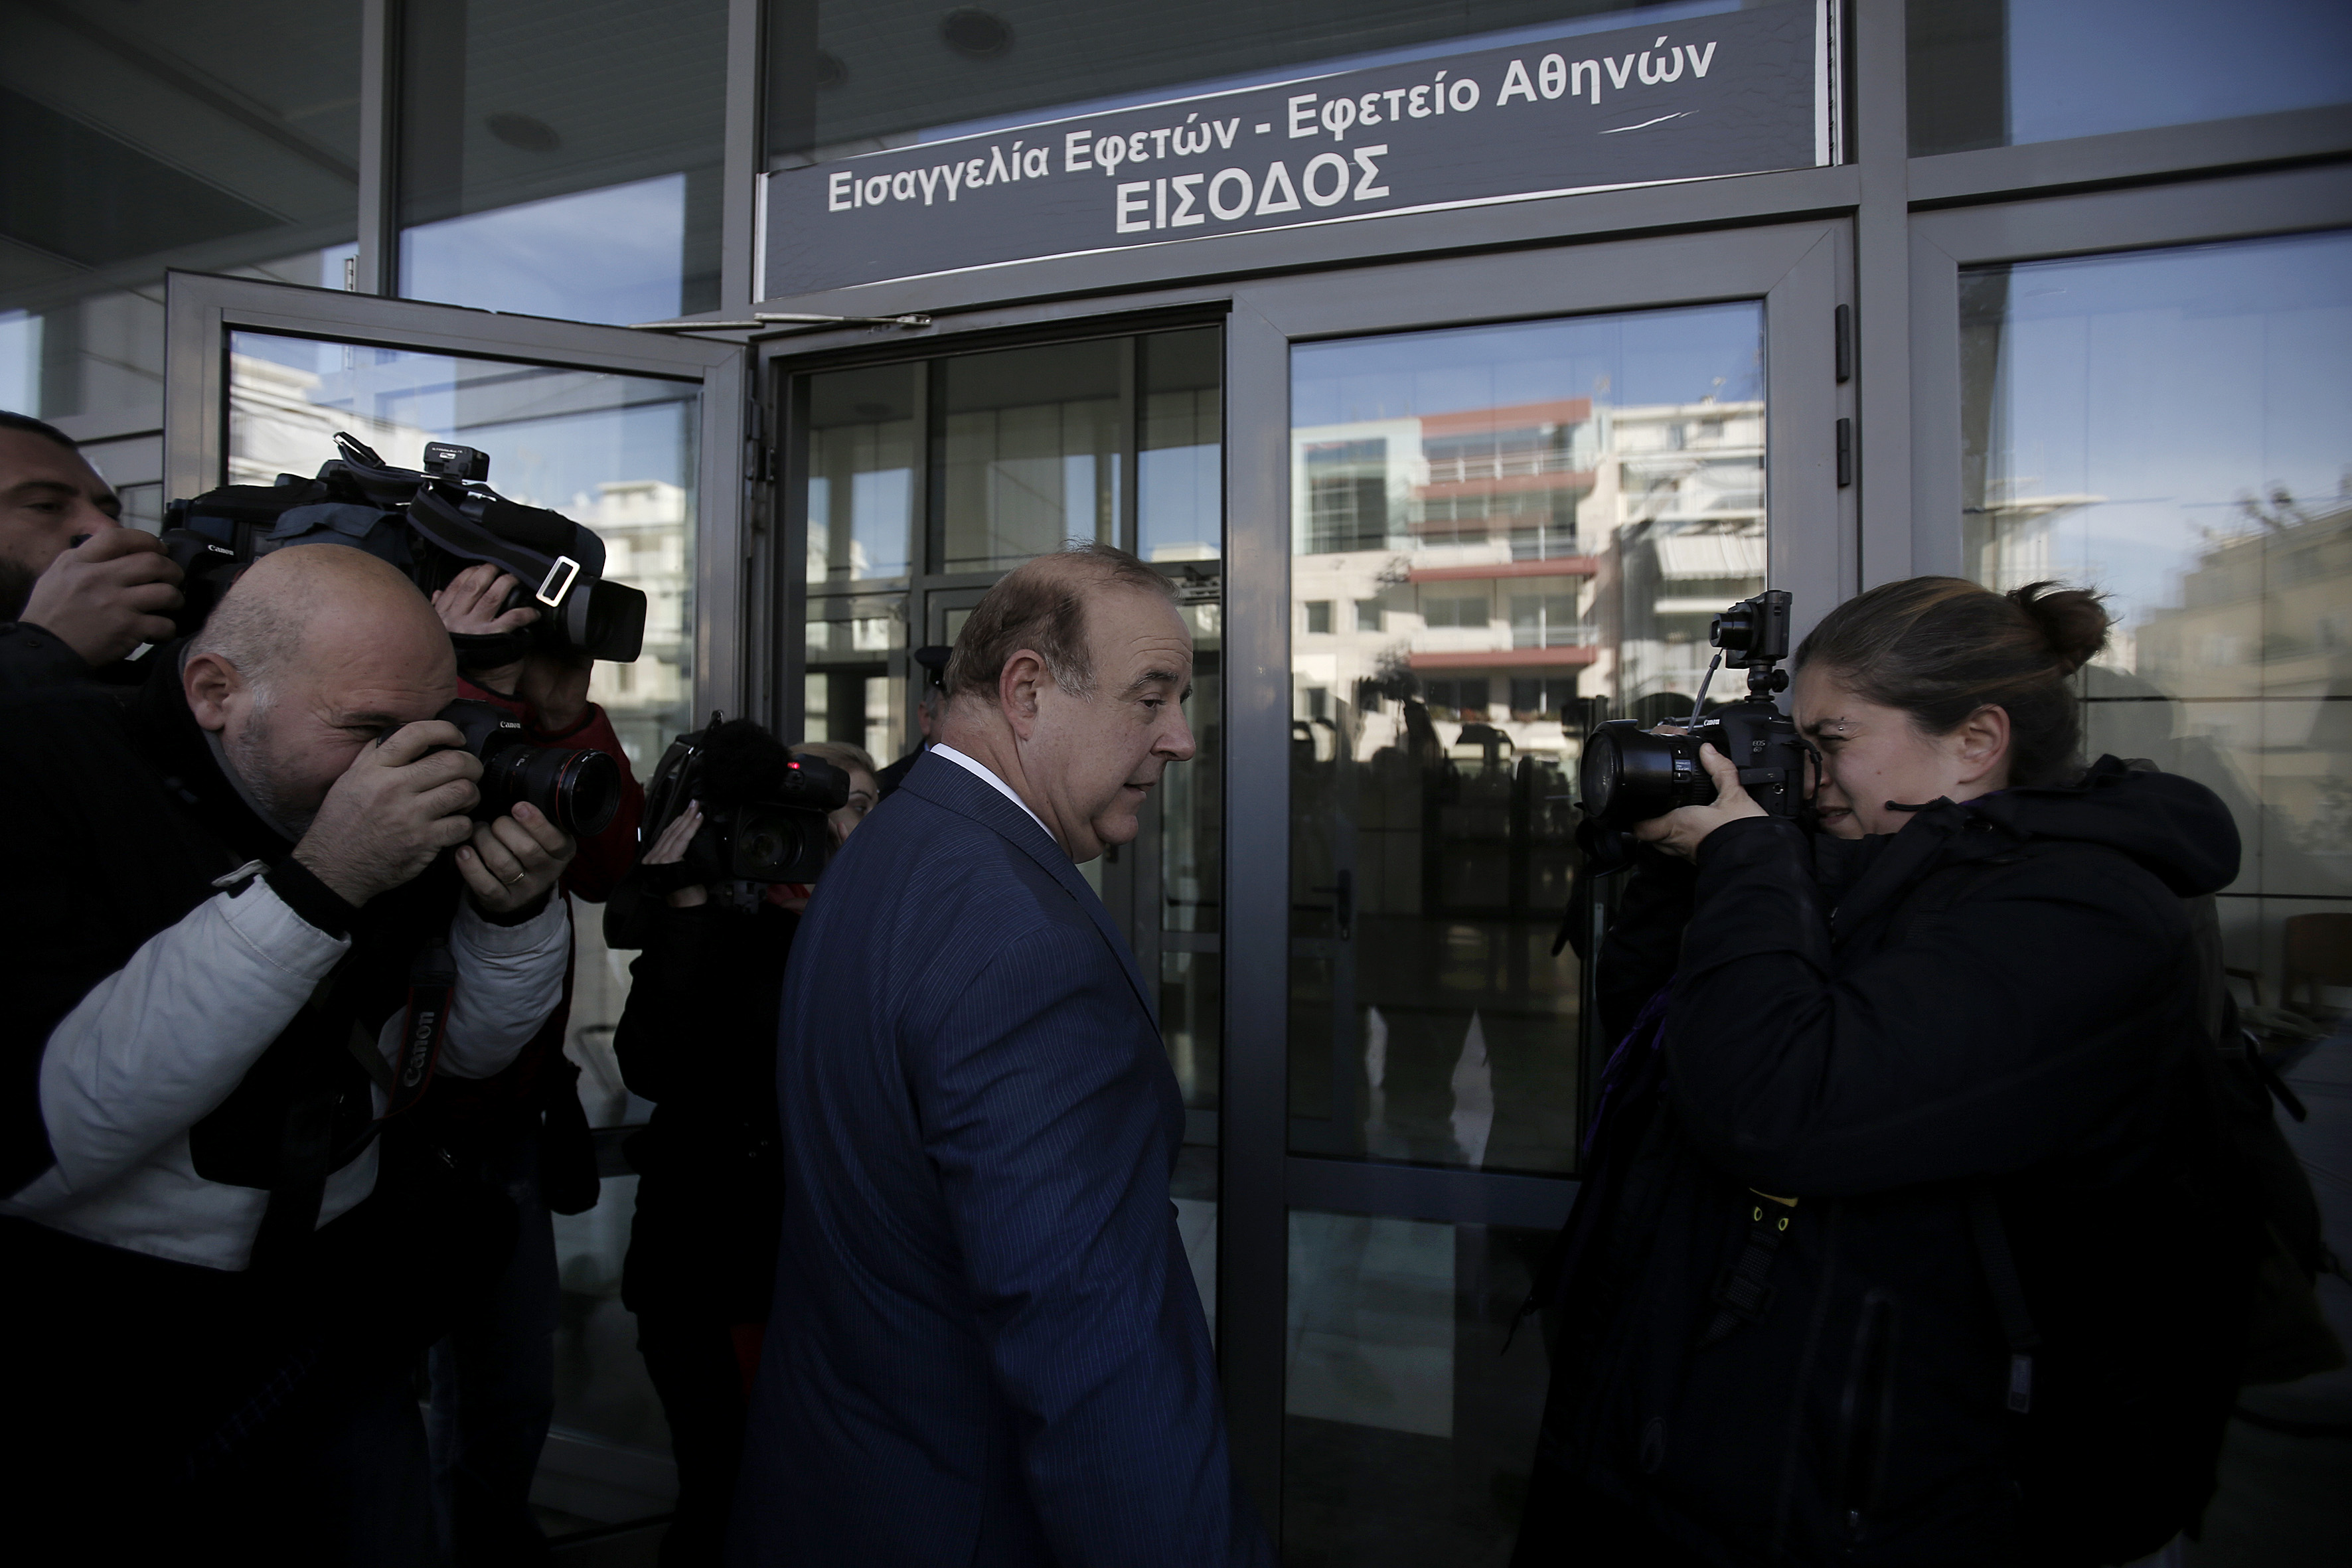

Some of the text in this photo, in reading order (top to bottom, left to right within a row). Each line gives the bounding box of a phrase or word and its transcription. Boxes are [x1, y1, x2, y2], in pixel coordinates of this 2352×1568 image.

[828, 141, 1050, 212] Εισαγγελία
[1065, 112, 1240, 176] Εφετών
[1289, 70, 1480, 141] Εφετείο
[1496, 35, 1717, 106] Αθηνών
[1116, 144, 1389, 234] ΕΙΣΟΔΟΣ
[207, 544, 234, 556] Canon
[403, 1011, 435, 1087] Canon
